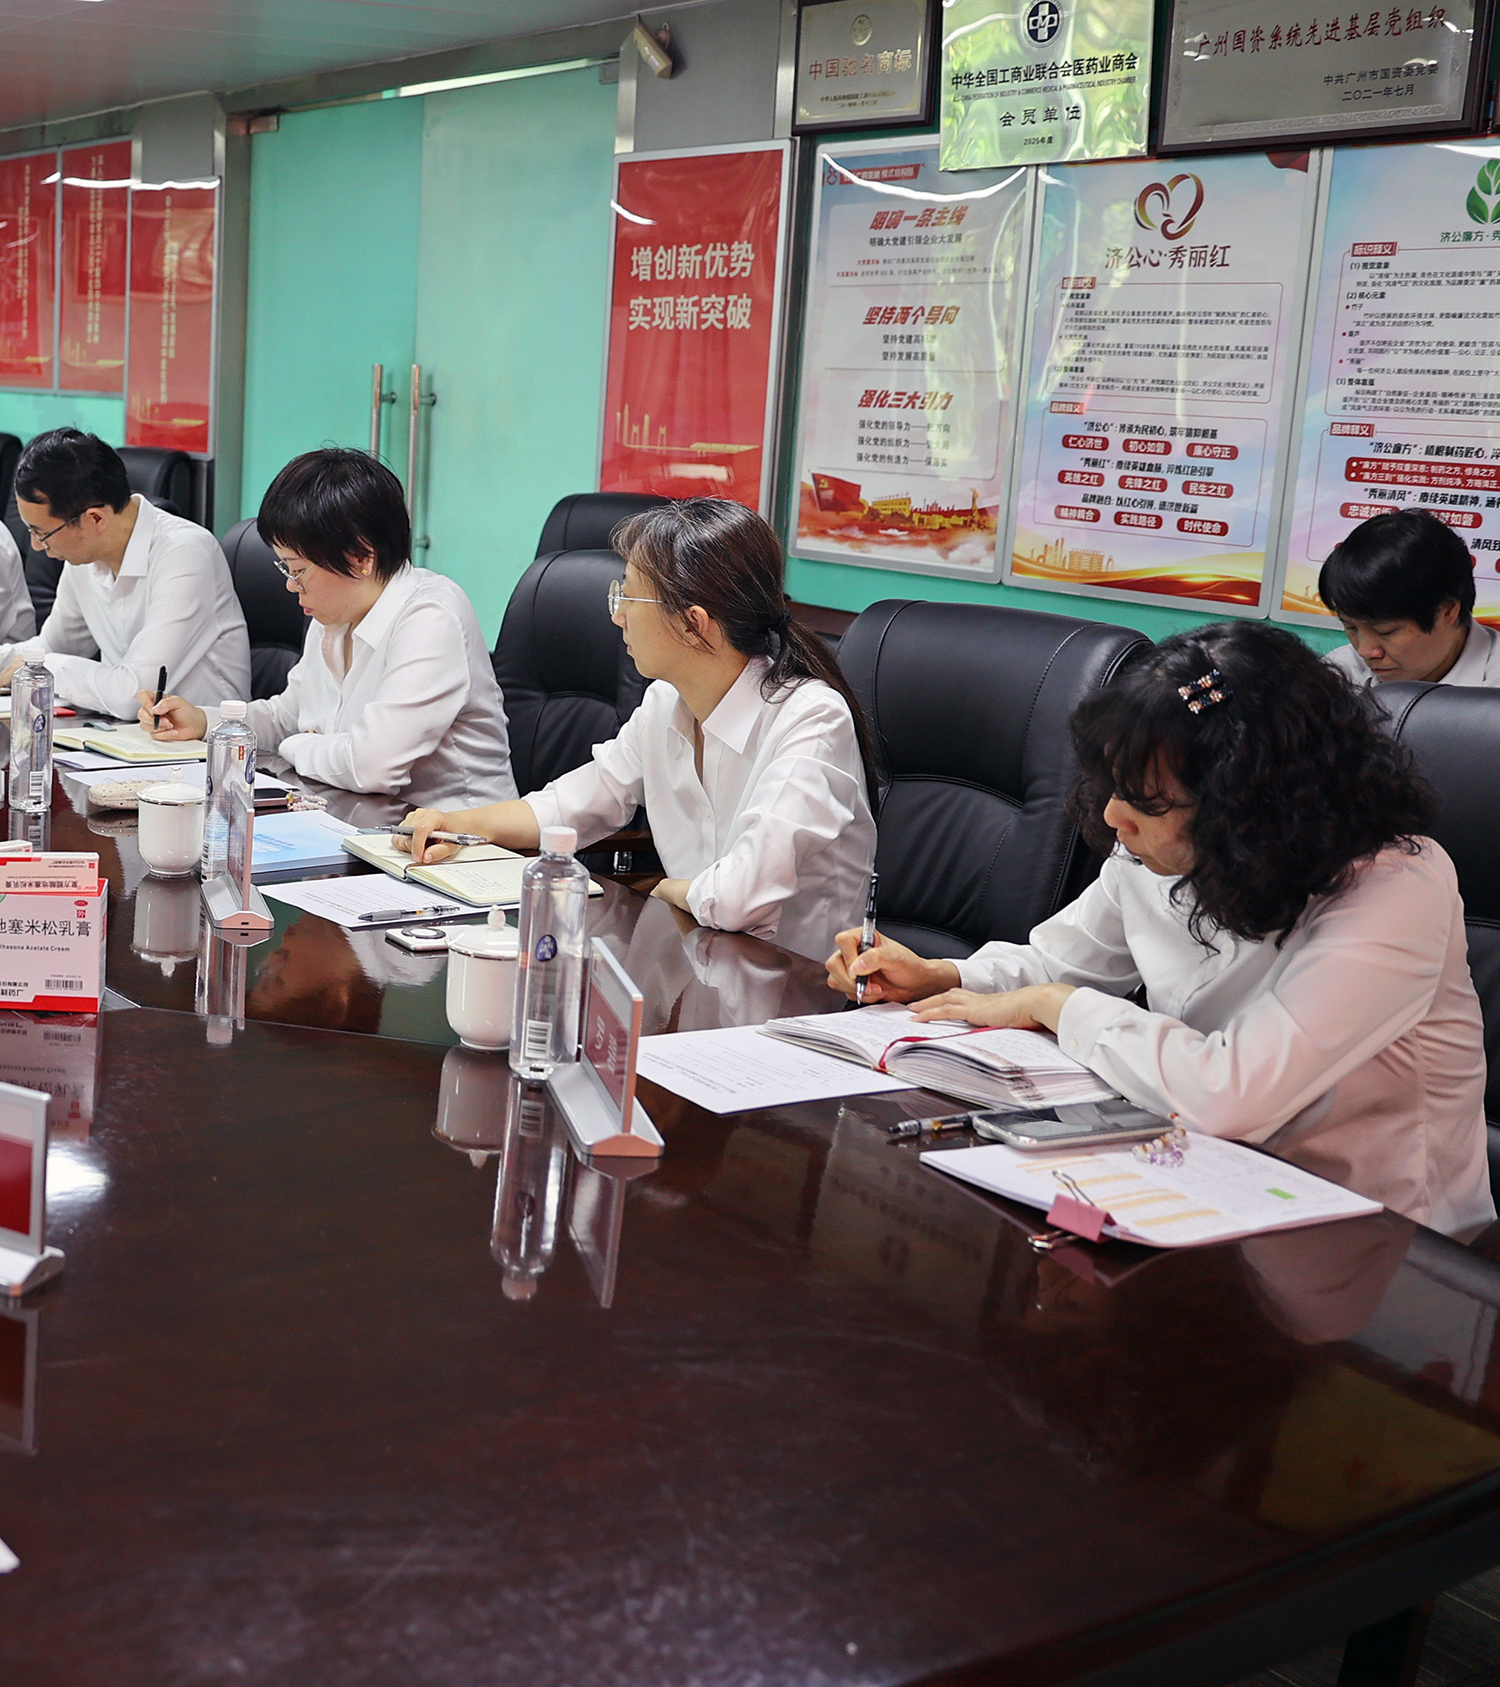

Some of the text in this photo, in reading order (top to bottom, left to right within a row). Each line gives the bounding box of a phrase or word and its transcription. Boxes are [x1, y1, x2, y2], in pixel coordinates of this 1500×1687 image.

[1195, 5, 1447, 57] 广州国资系统先进基层党组织
[809, 49, 912, 80] 中国驰名商标
[951, 52, 1139, 90] 中华全国工商业联合会医药业商会
[1323, 63, 1438, 86] 中共广州市国资委党委
[1000, 105, 1082, 127] 会员单位
[1023, 136, 1053, 146] 2025年度
[869, 206, 969, 230] 明确一条主线
[869, 233, 963, 247] 明确大党建引领企业大发展
[630, 241, 755, 281] 增创新优势
[1104, 244, 1232, 269] 济公心·秀丽红
[628, 293, 752, 330] 实现新突破
[862, 306, 961, 325] 坚持两个导向
[857, 389, 954, 410] 强化三大引力
[1331, 424, 1370, 436] 品牌释义
[1068, 437, 1231, 458] 仁心济世 初心如磐 廉心守正
[1064, 473, 1228, 497] 英雄之红 先锋之红 民生之红
[1121, 514, 1157, 527] 实践路径
[1184, 521, 1223, 534] 时代使命
[26, 944, 49, 952] Acetate
